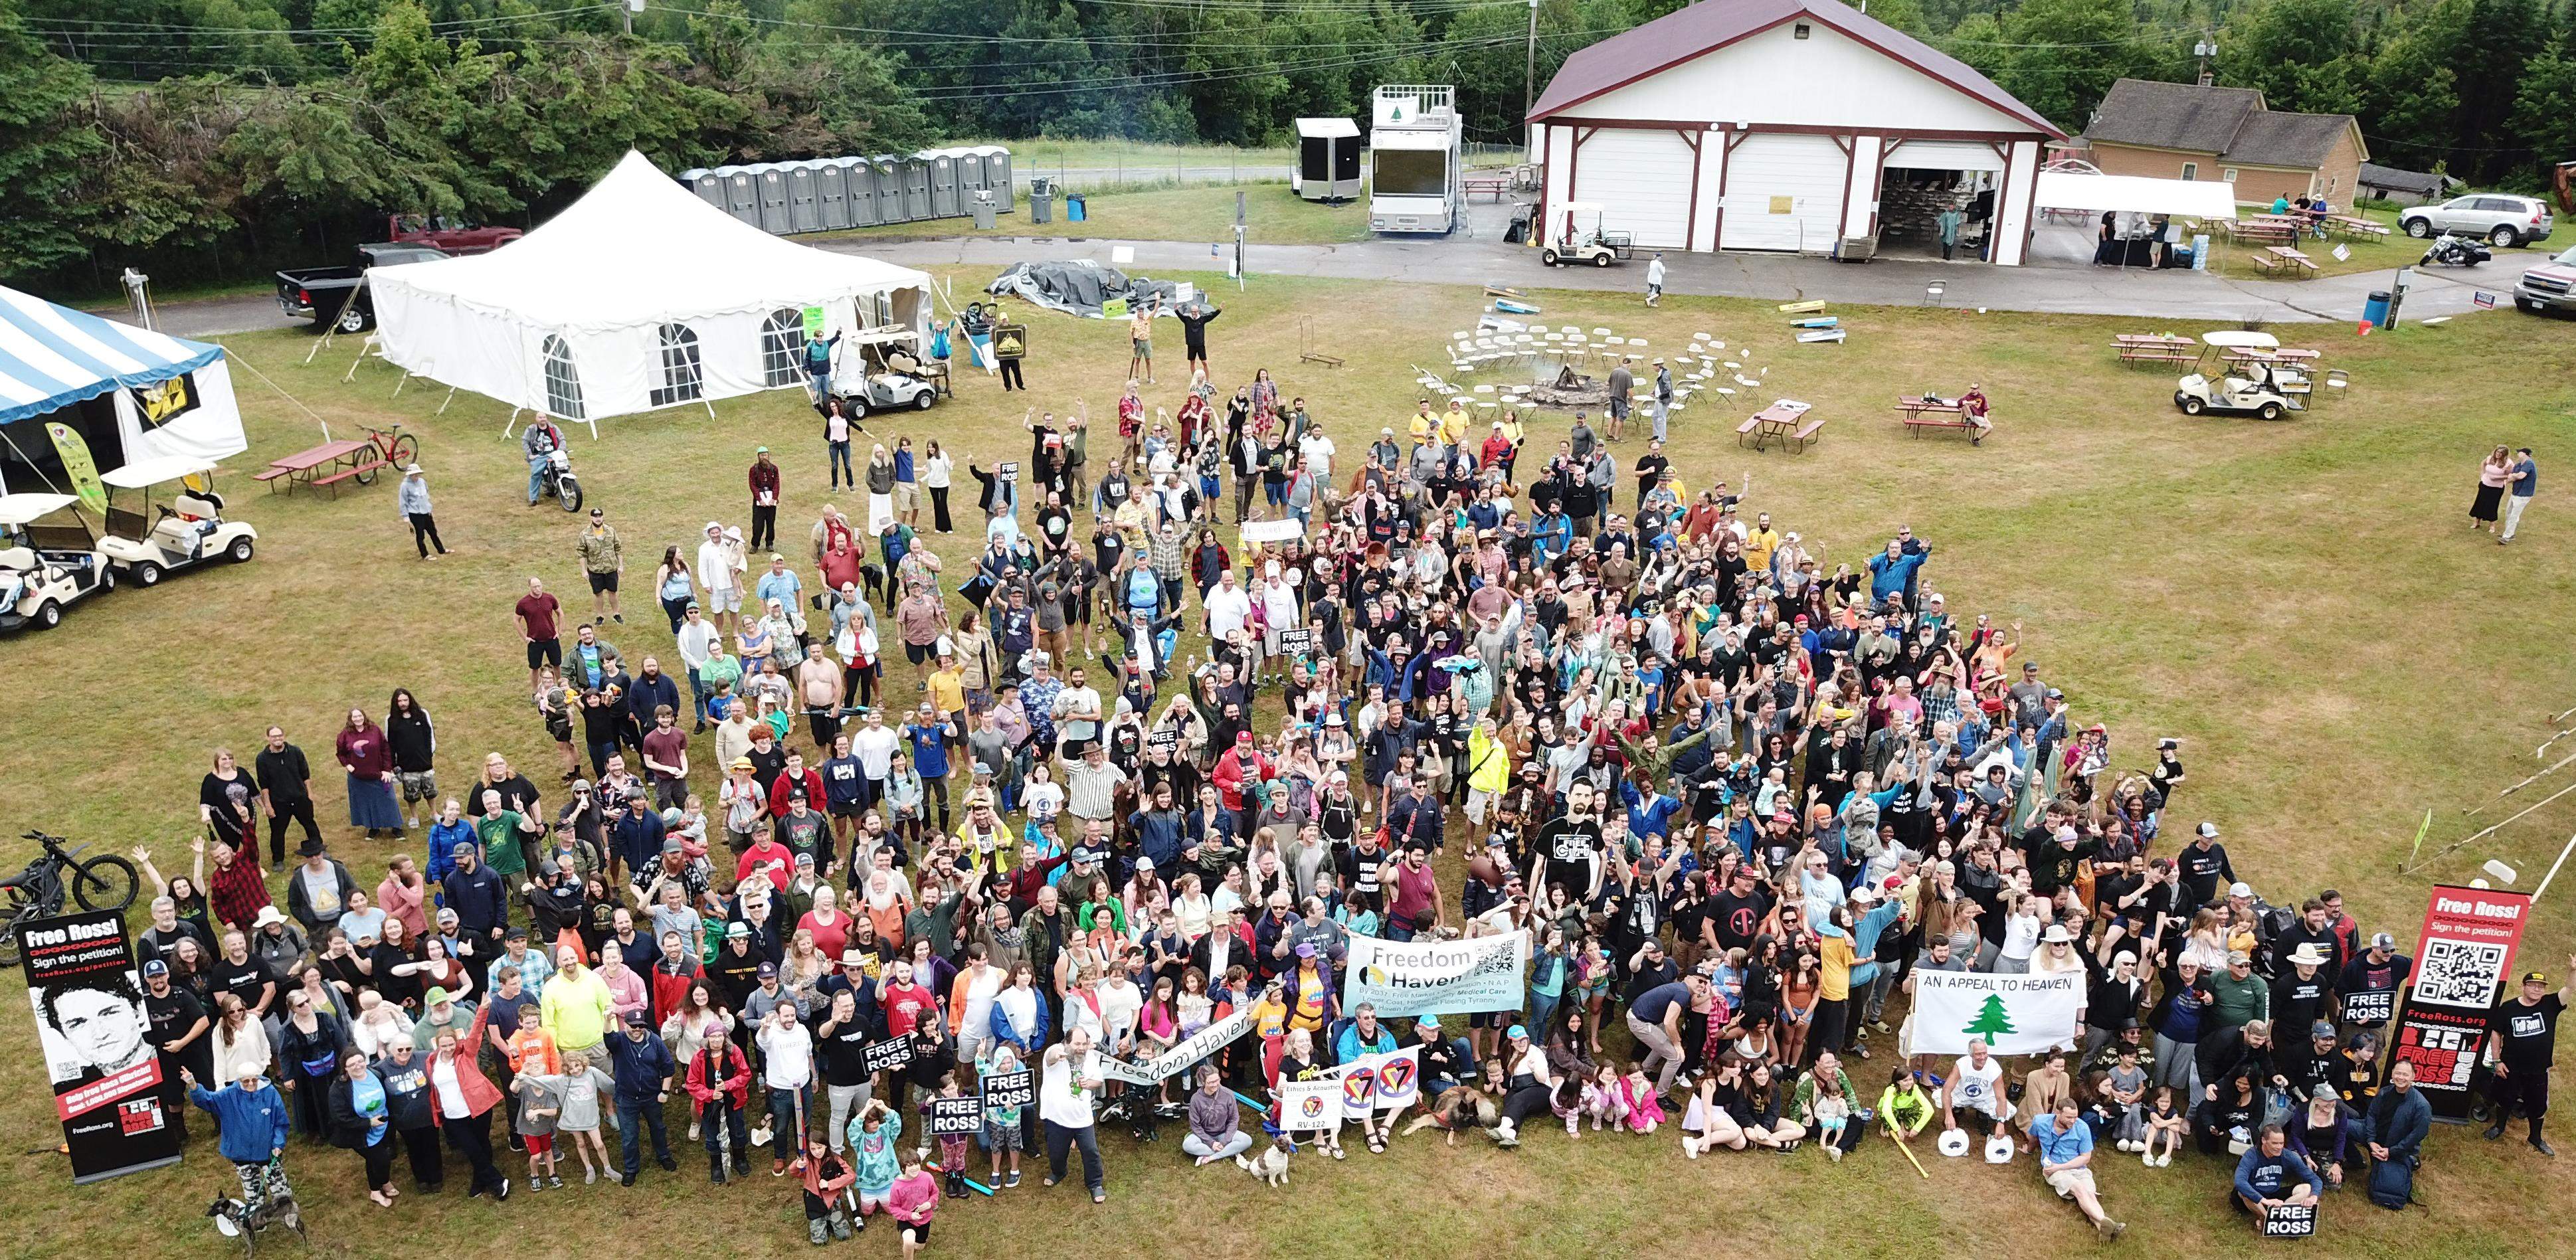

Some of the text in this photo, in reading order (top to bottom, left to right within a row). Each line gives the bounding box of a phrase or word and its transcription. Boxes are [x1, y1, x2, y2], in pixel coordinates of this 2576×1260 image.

[1002, 464, 1018, 472] FREE
[1282, 630, 1309, 642] FREE
[1282, 642, 1310, 654] ROSS
[1151, 731, 1174, 743] REE
[1147, 742, 1176, 755] RSS
[834, 764, 855, 780] NH
[2436, 897, 2521, 919] Free Ross!
[25, 918, 119, 947] Free Ross!
[2431, 922, 2512, 937] Sign the petition!
[33, 945, 124, 968] Sign the petition!
[1372, 946, 1470, 968] Freedom
[35, 960, 127, 978] FreeRoss.org/petition
[1392, 972, 1463, 988] Haven
[1924, 976, 2072, 991] AN APPEAL TO HEAVEN
[2349, 994, 2390, 1006] FREE
[2346, 1007, 2389, 1020] ROSS
[2407, 1009, 2487, 1027] FreeRoss.org
[866, 1037, 907, 1060] FREE
[1099, 1016, 1251, 1081] Freedom Haven
[2395, 1045, 2458, 1067] FREE
[867, 1049, 911, 1071] ROSS
[988, 1073, 1029, 1091] FREE
[2413, 1064, 2453, 1084] OSS
[66, 1093, 84, 1105] Help
[84, 1085, 100, 1099] free
[100, 1078, 119, 1092] Ross
[987, 1088, 1032, 1105] ROSS
[936, 1100, 978, 1115] FREE
[72, 1121, 114, 1134] FreeRoss.org
[935, 1116, 980, 1131] ROSS
[2270, 1206, 2312, 1219] FREE
[2266, 1220, 2311, 1234] ROSS
